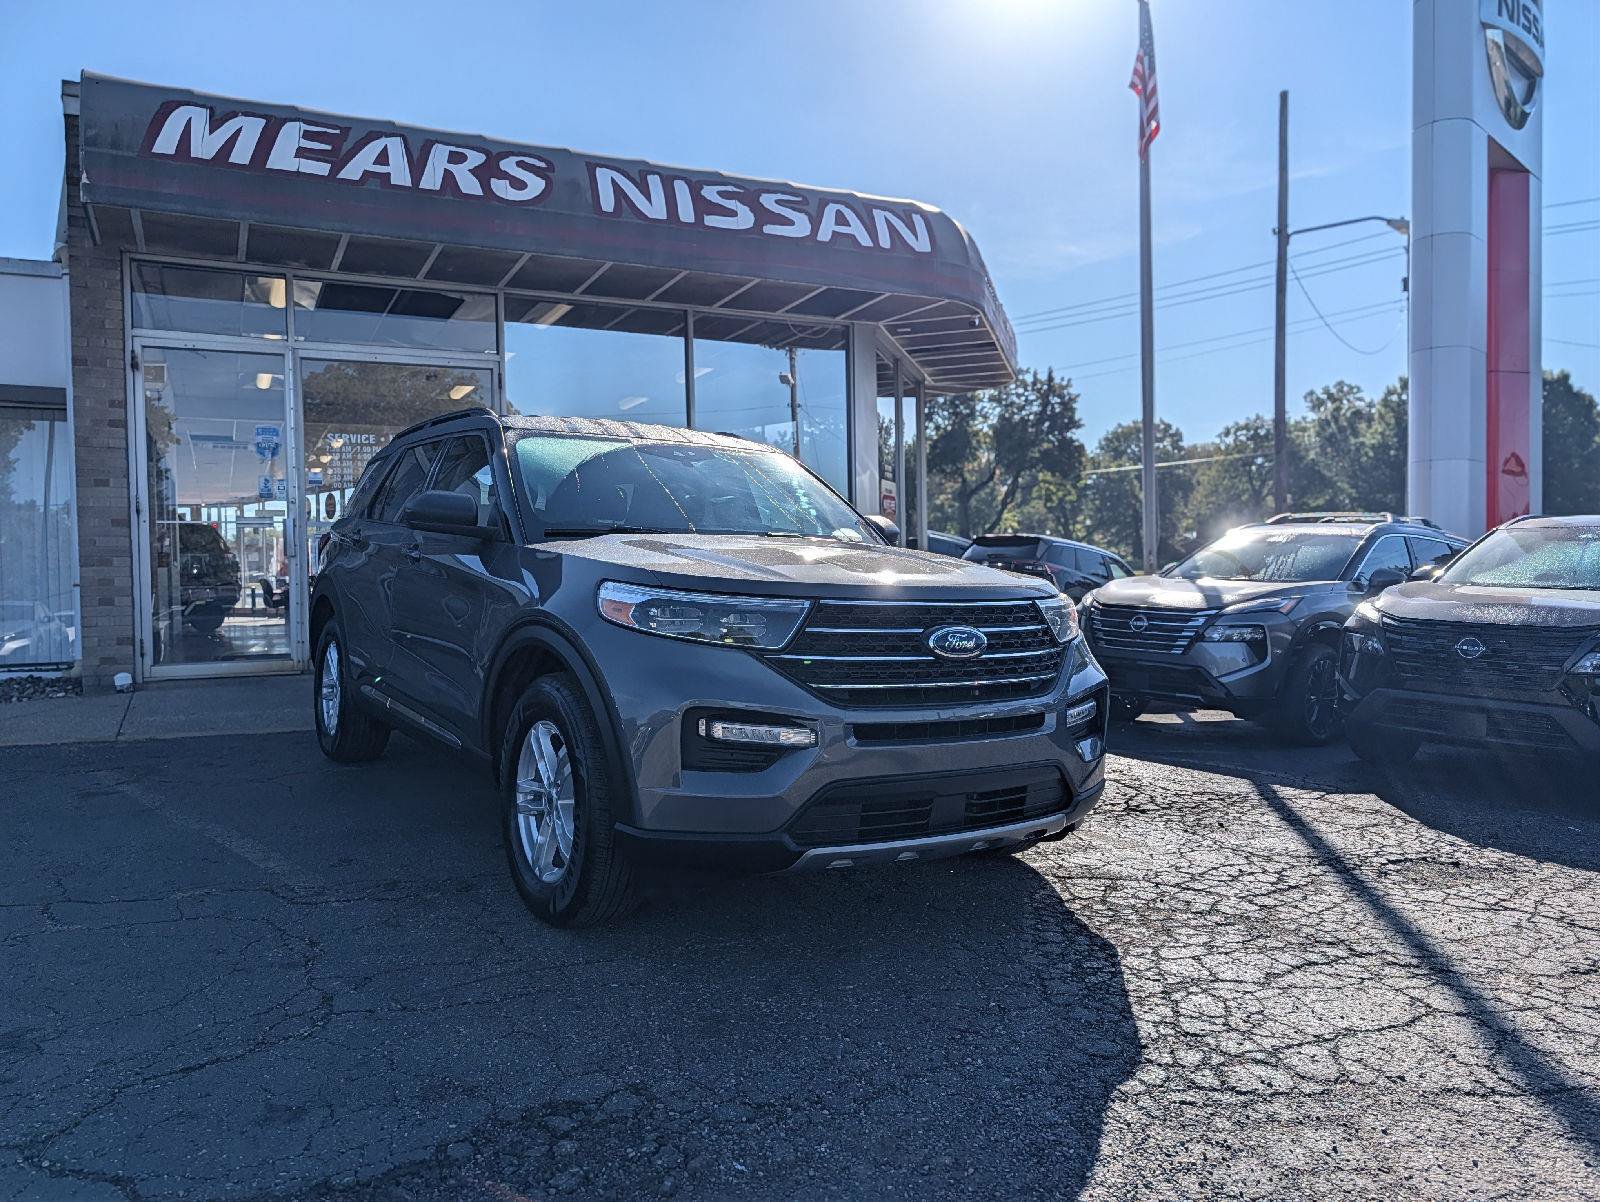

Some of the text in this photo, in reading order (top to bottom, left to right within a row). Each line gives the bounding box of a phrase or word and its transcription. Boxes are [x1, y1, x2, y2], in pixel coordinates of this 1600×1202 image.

[1498, 0, 1544, 48] NISS
[151, 105, 932, 253] MEARS NISSAN
[327, 433, 376, 444] SERVICE
[945, 633, 976, 650] Ford
